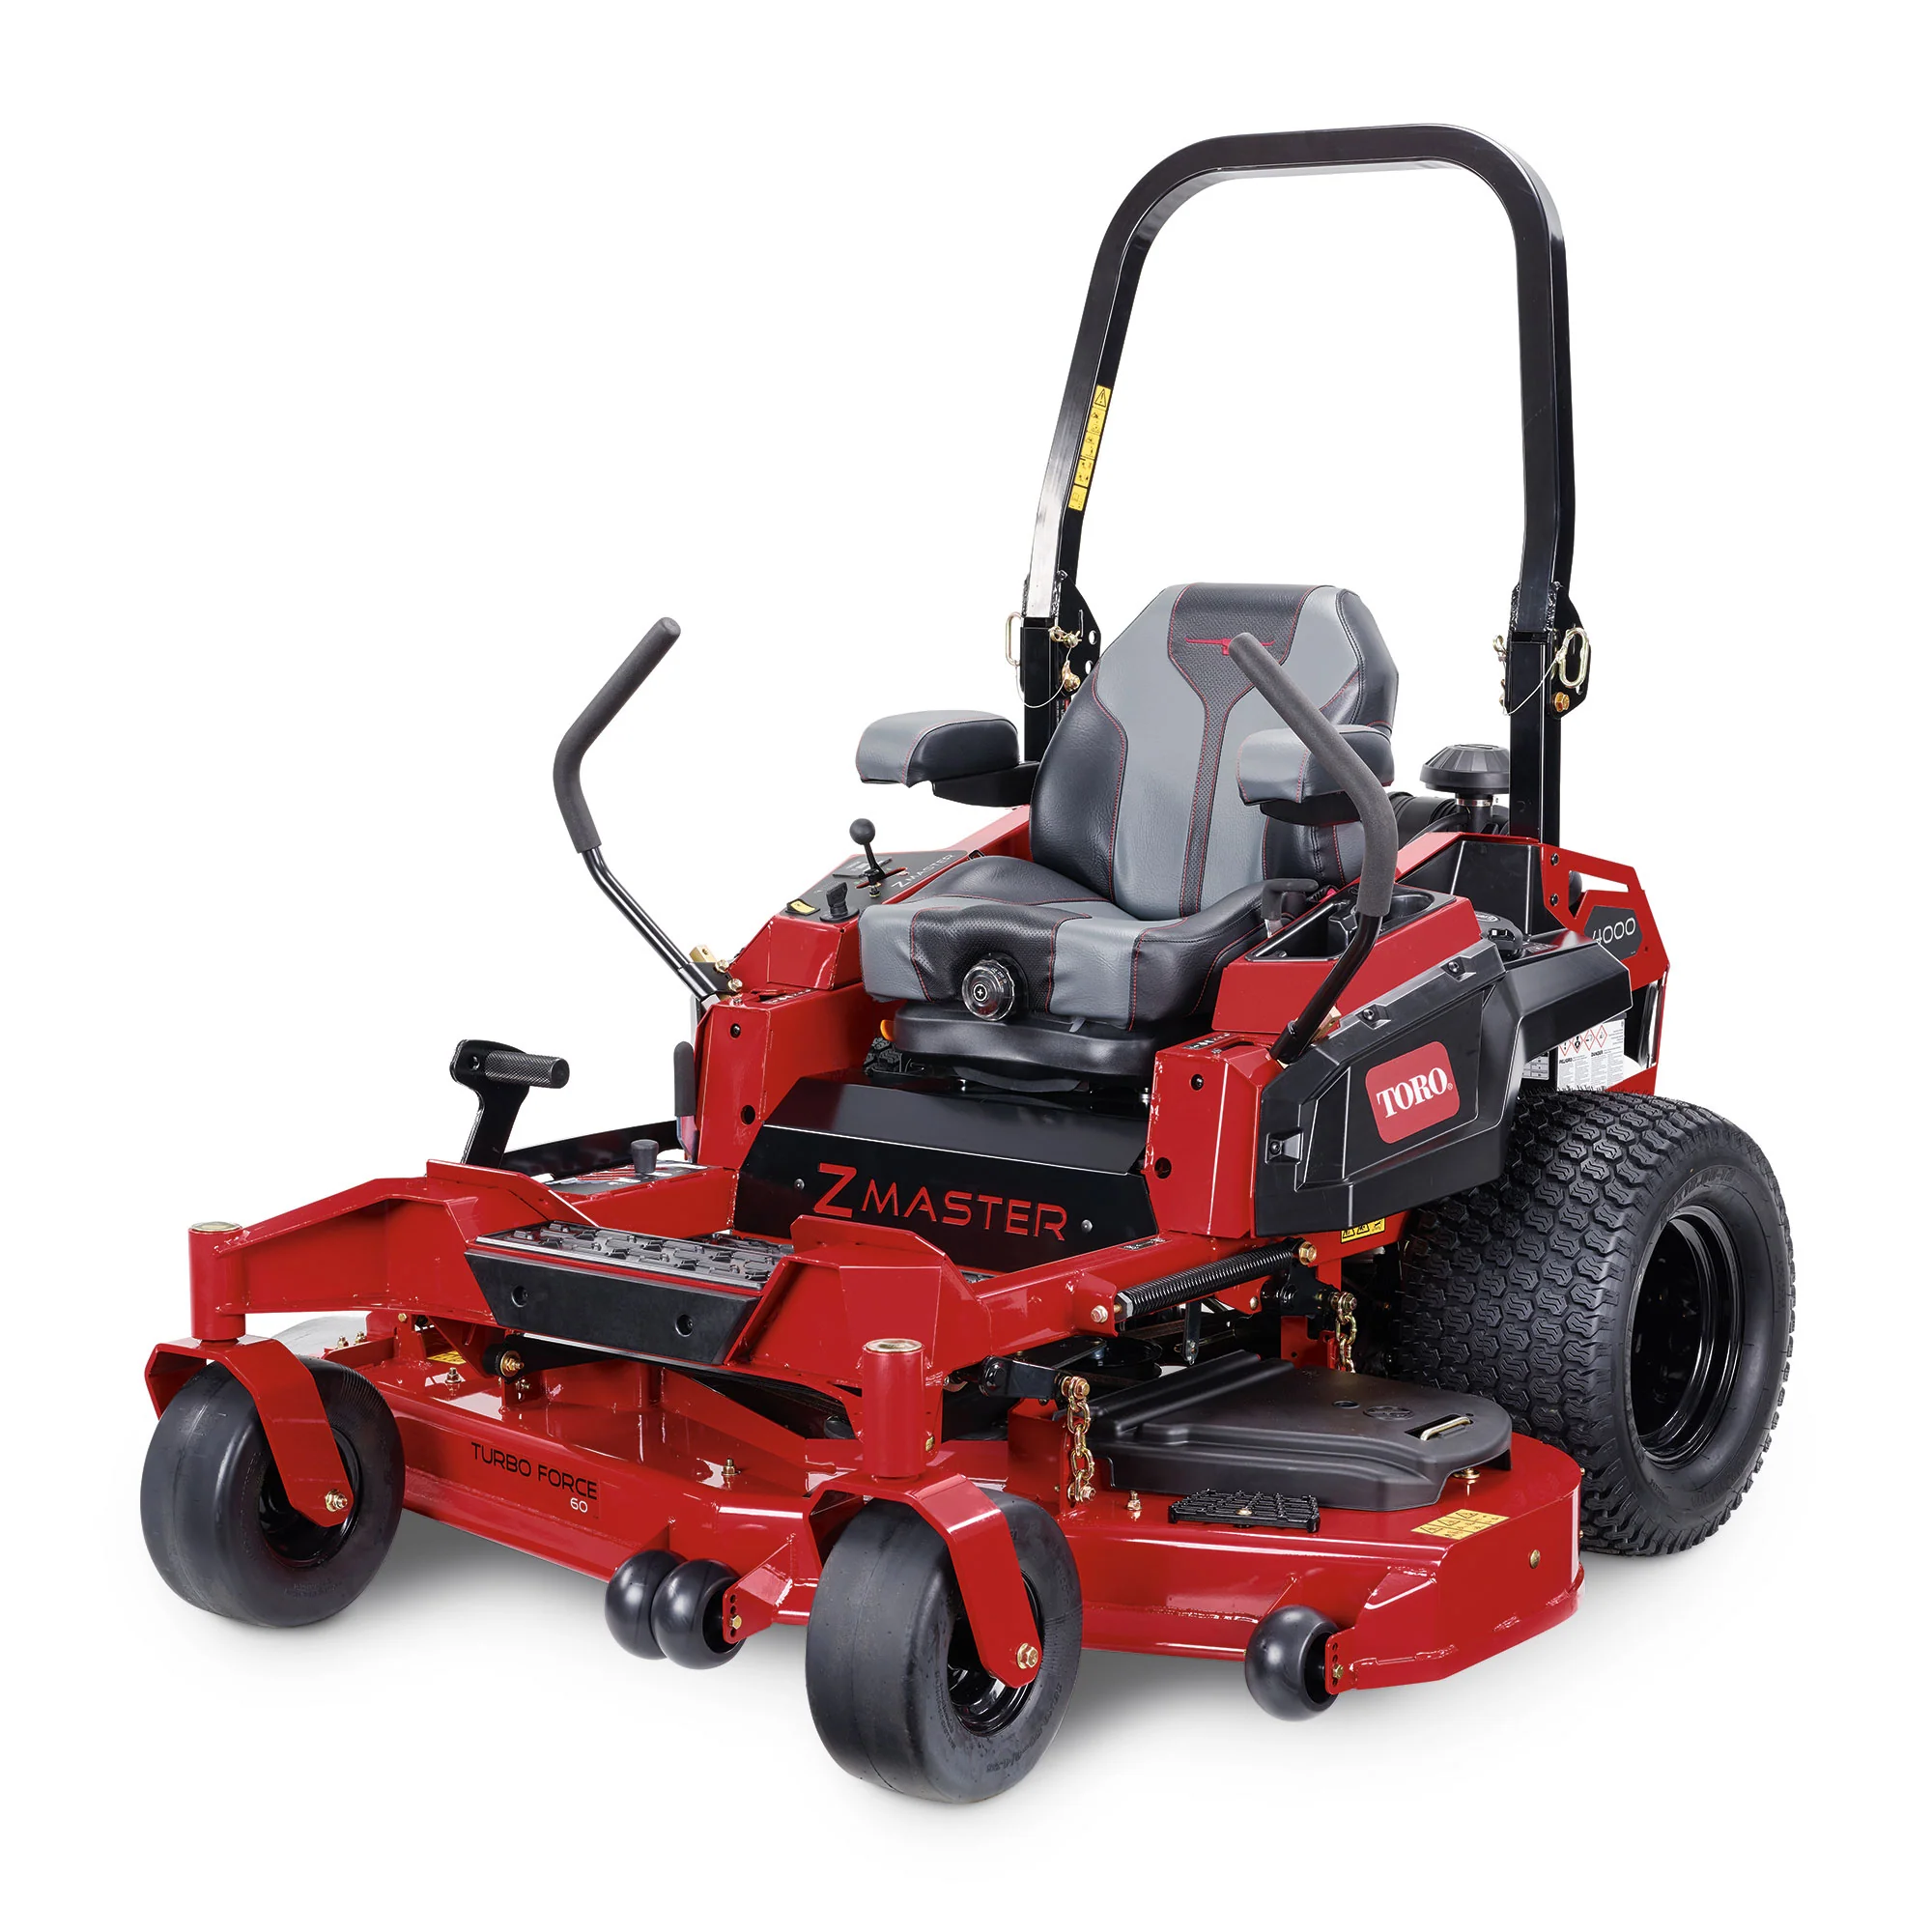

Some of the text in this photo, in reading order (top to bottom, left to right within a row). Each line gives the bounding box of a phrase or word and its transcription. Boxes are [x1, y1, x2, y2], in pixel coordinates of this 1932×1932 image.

[1592, 917, 1636, 945] 4000
[1376, 1066, 1448, 1119] TORO
[812, 1162, 1067, 1240] Z MASTER
[470, 1441, 598, 1500] TURBO FORCE
[570, 1496, 588, 1513] 60
